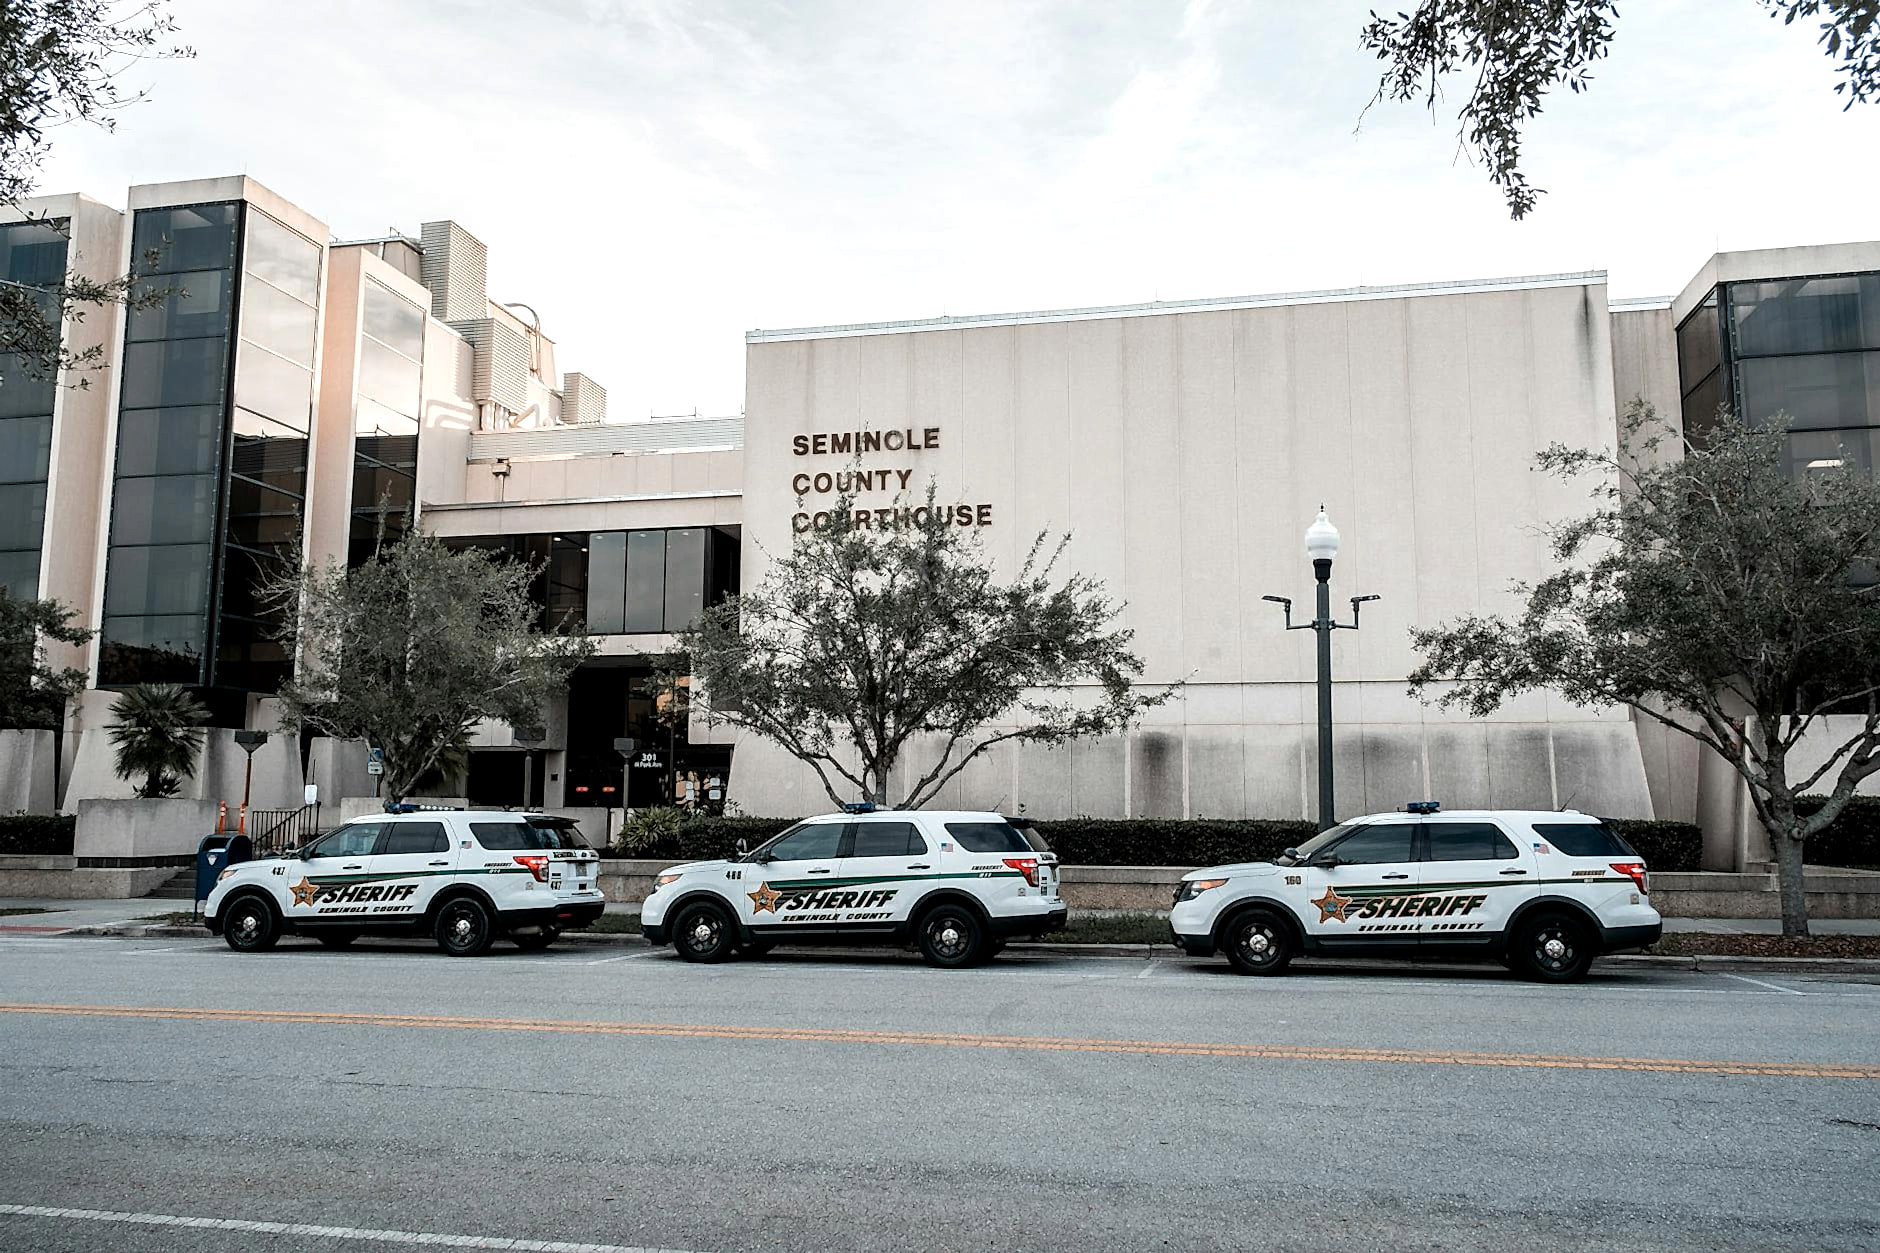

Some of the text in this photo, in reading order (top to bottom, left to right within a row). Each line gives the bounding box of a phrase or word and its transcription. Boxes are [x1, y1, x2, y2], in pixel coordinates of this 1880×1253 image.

[793, 427, 940, 456] SEMINOLE
[792, 469, 912, 496] COUNTY
[791, 504, 992, 534] CORTHOUSE
[641, 752, 657, 761] 301
[322, 884, 419, 904] SHERIFF
[785, 889, 899, 911] SHERIFF
[781, 914, 841, 922] SEMINOLE
[1358, 895, 1489, 919] SHERIFF
